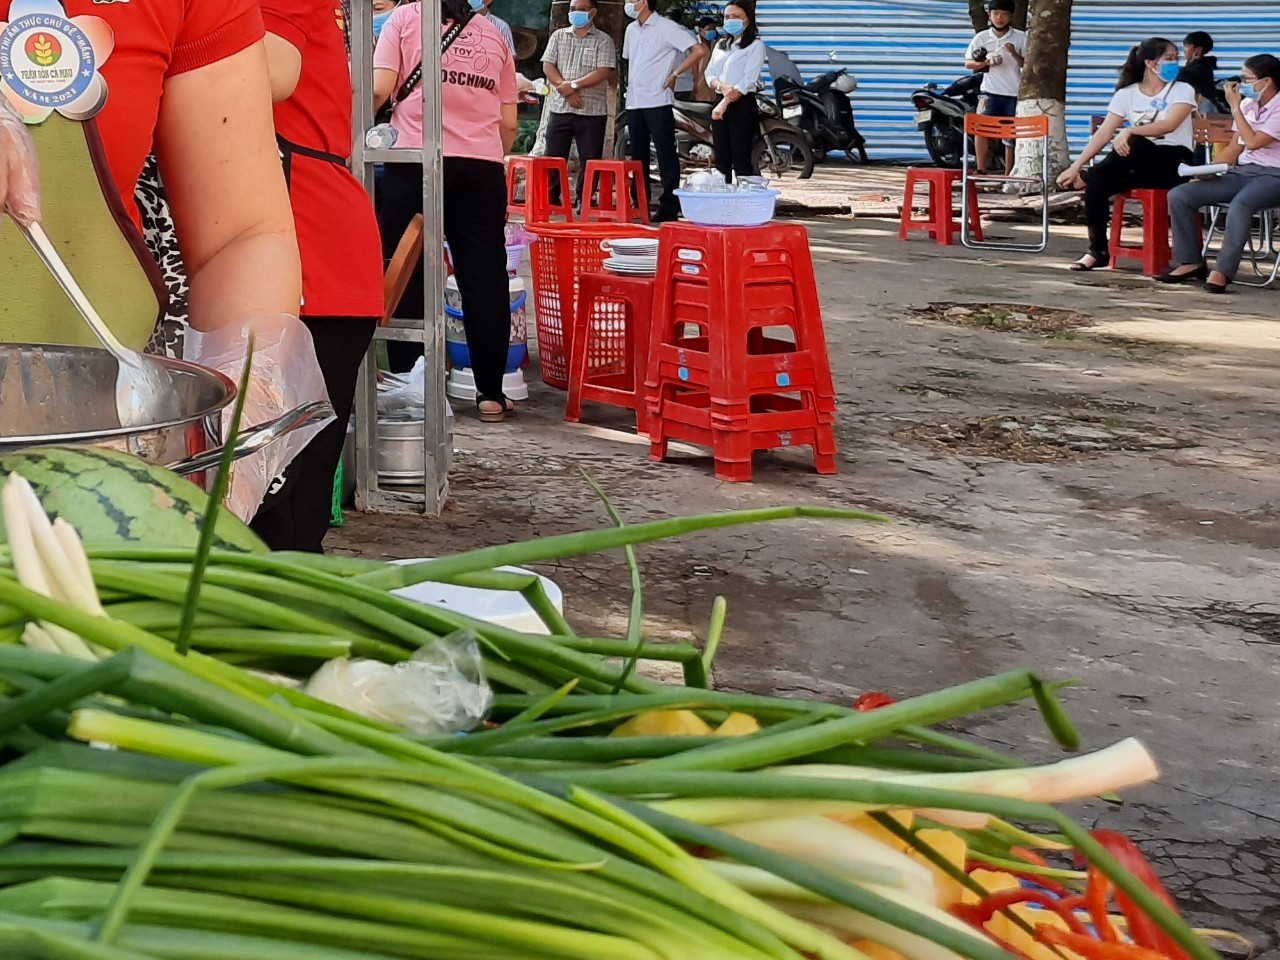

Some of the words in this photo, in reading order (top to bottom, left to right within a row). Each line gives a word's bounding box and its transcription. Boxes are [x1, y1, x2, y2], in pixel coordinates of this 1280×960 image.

[453, 46, 473, 57] TOY
[441, 69, 496, 91] OSCHINO
[52, 87, 77, 103] 2021
